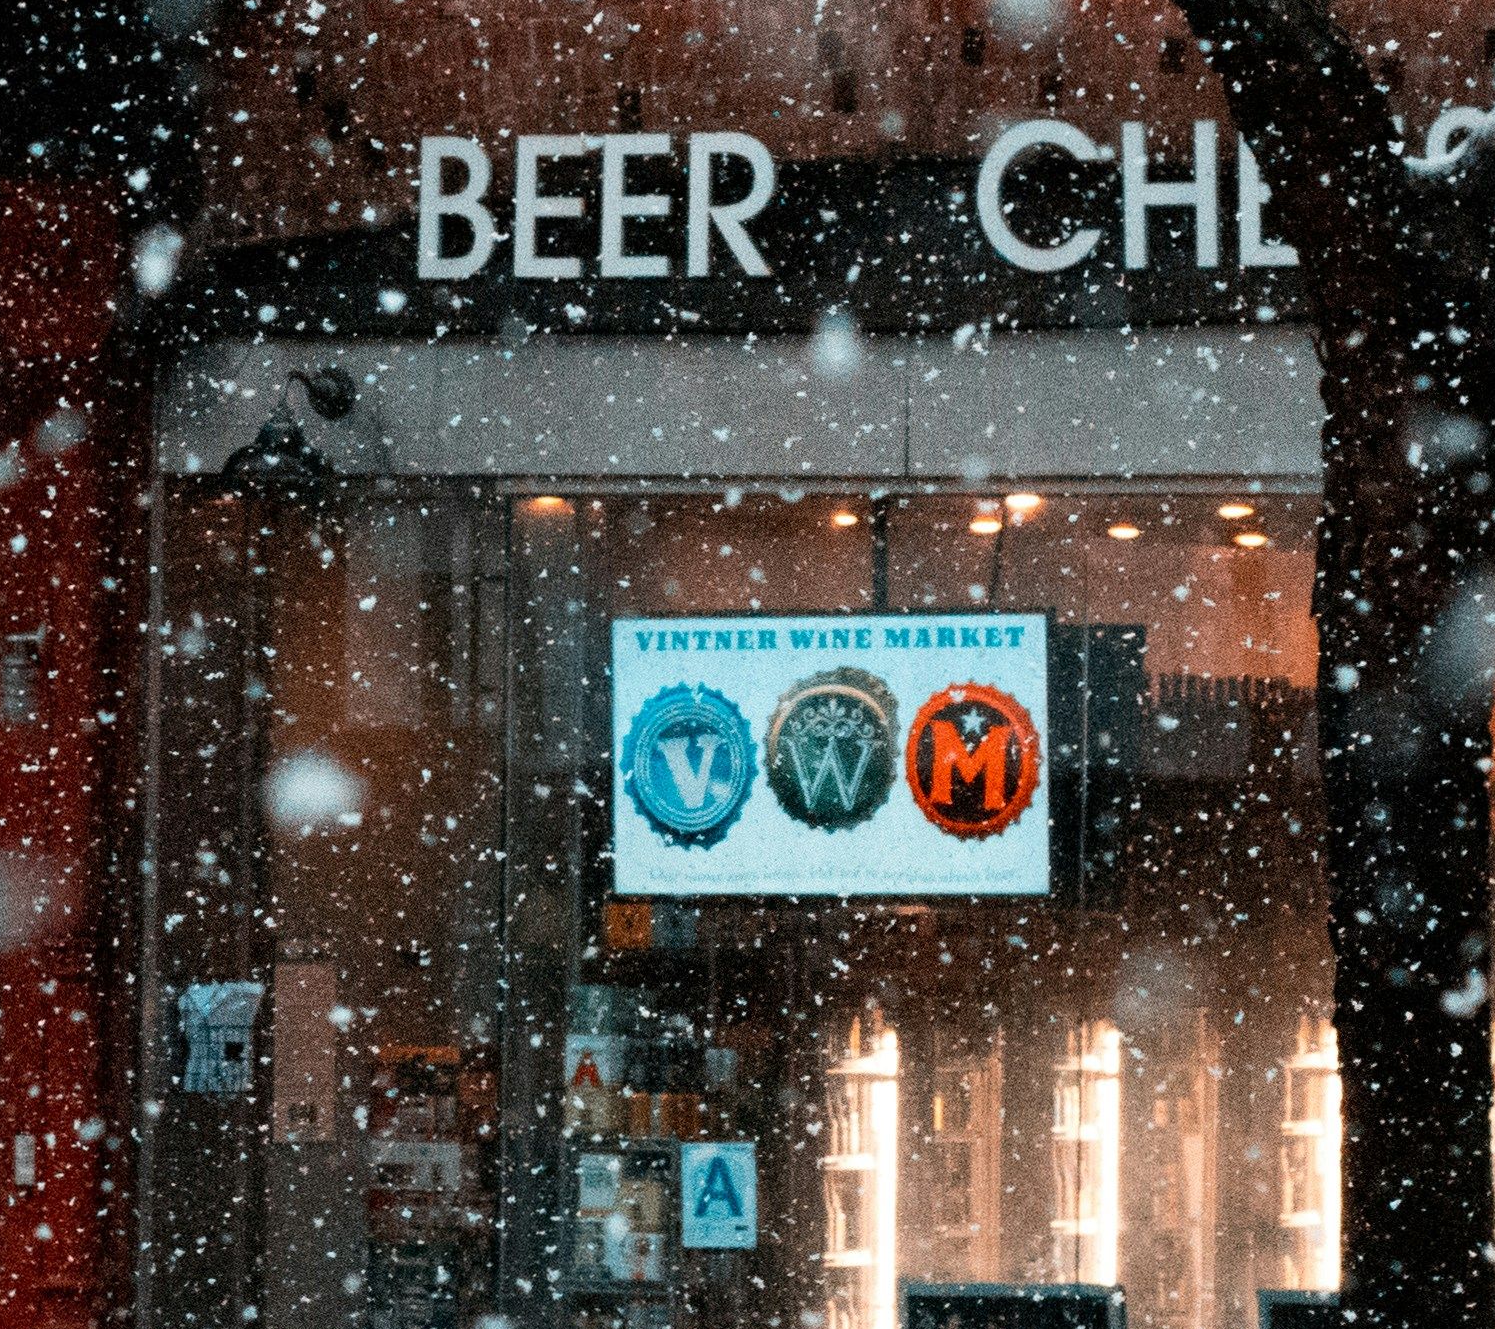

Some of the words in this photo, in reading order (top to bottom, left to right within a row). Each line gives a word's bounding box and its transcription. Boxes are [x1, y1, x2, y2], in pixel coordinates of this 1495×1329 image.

[414, 131, 776, 281] BEER
[634, 628, 778, 652] VINTNER
[790, 628, 872, 650] WINE
[883, 625, 1026, 649] MARKET
[656, 733, 729, 810] V
[786, 734, 881, 811] W
[930, 720, 1013, 812] M
[693, 1155, 745, 1218] A
